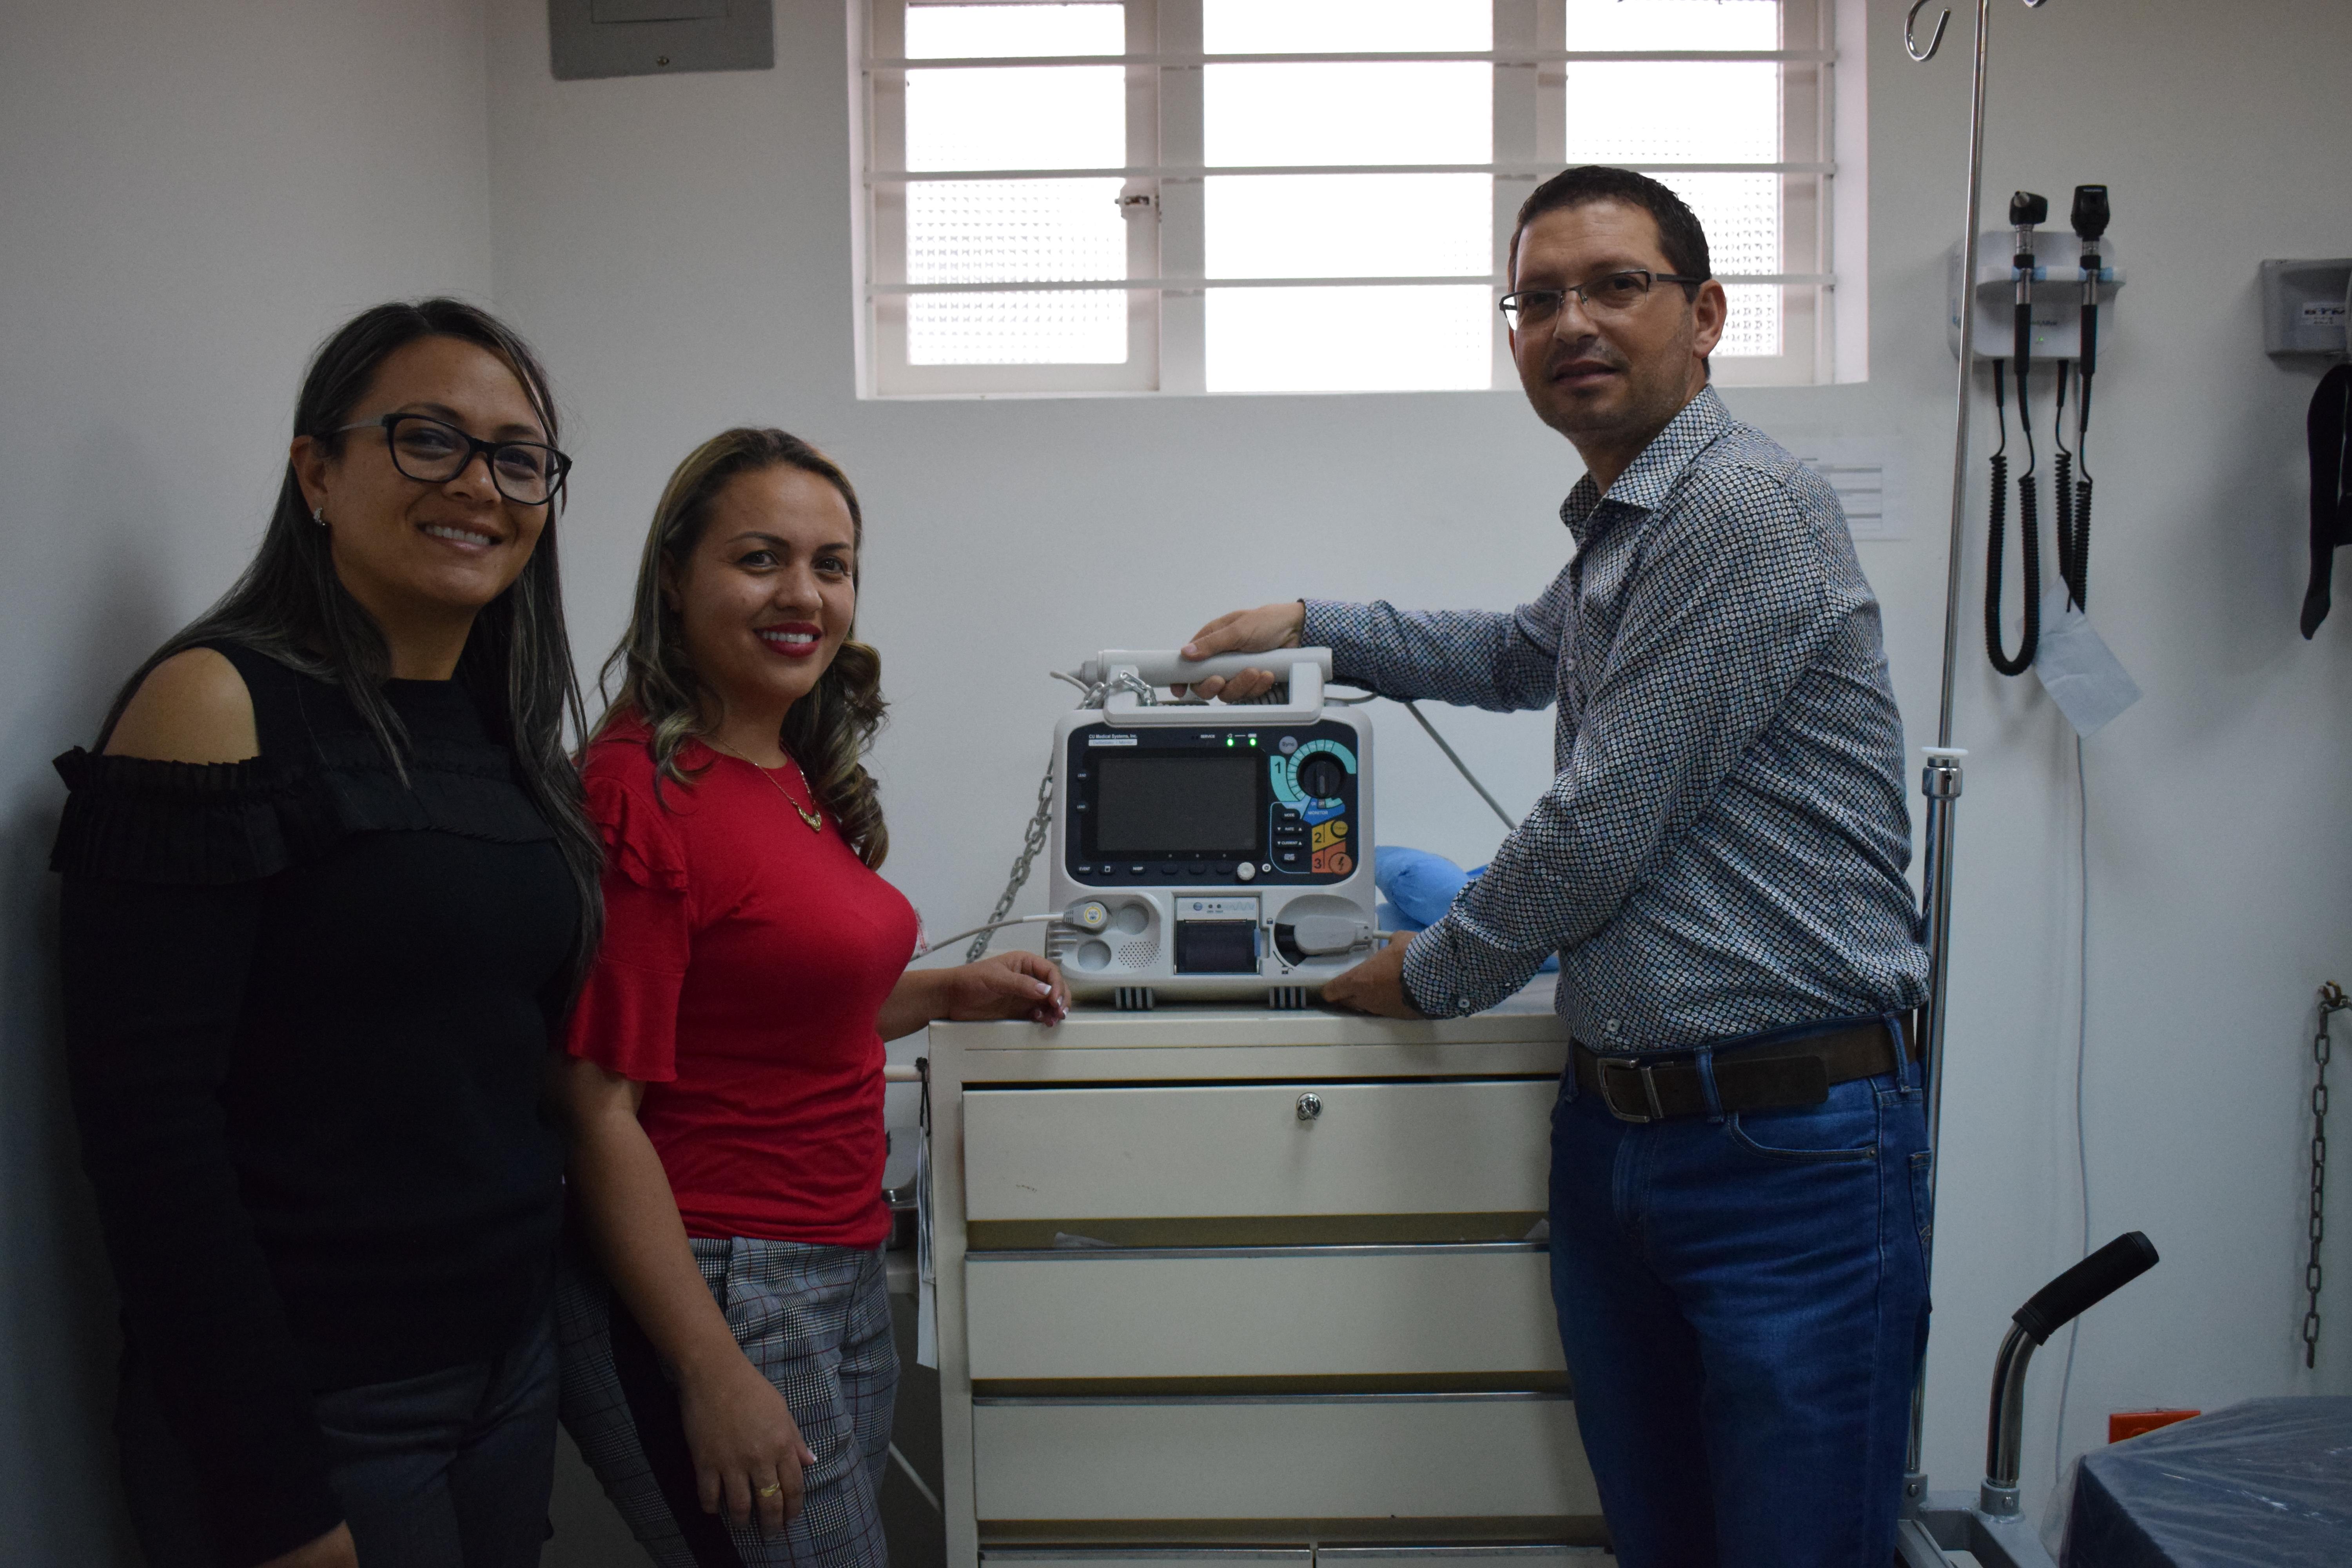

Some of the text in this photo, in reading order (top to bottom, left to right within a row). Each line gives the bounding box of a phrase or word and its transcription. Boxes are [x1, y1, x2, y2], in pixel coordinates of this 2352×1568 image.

[1275, 761, 1281, 774] 1
[1314, 832, 1322, 843] 2
[1314, 858, 1322, 869] 3
